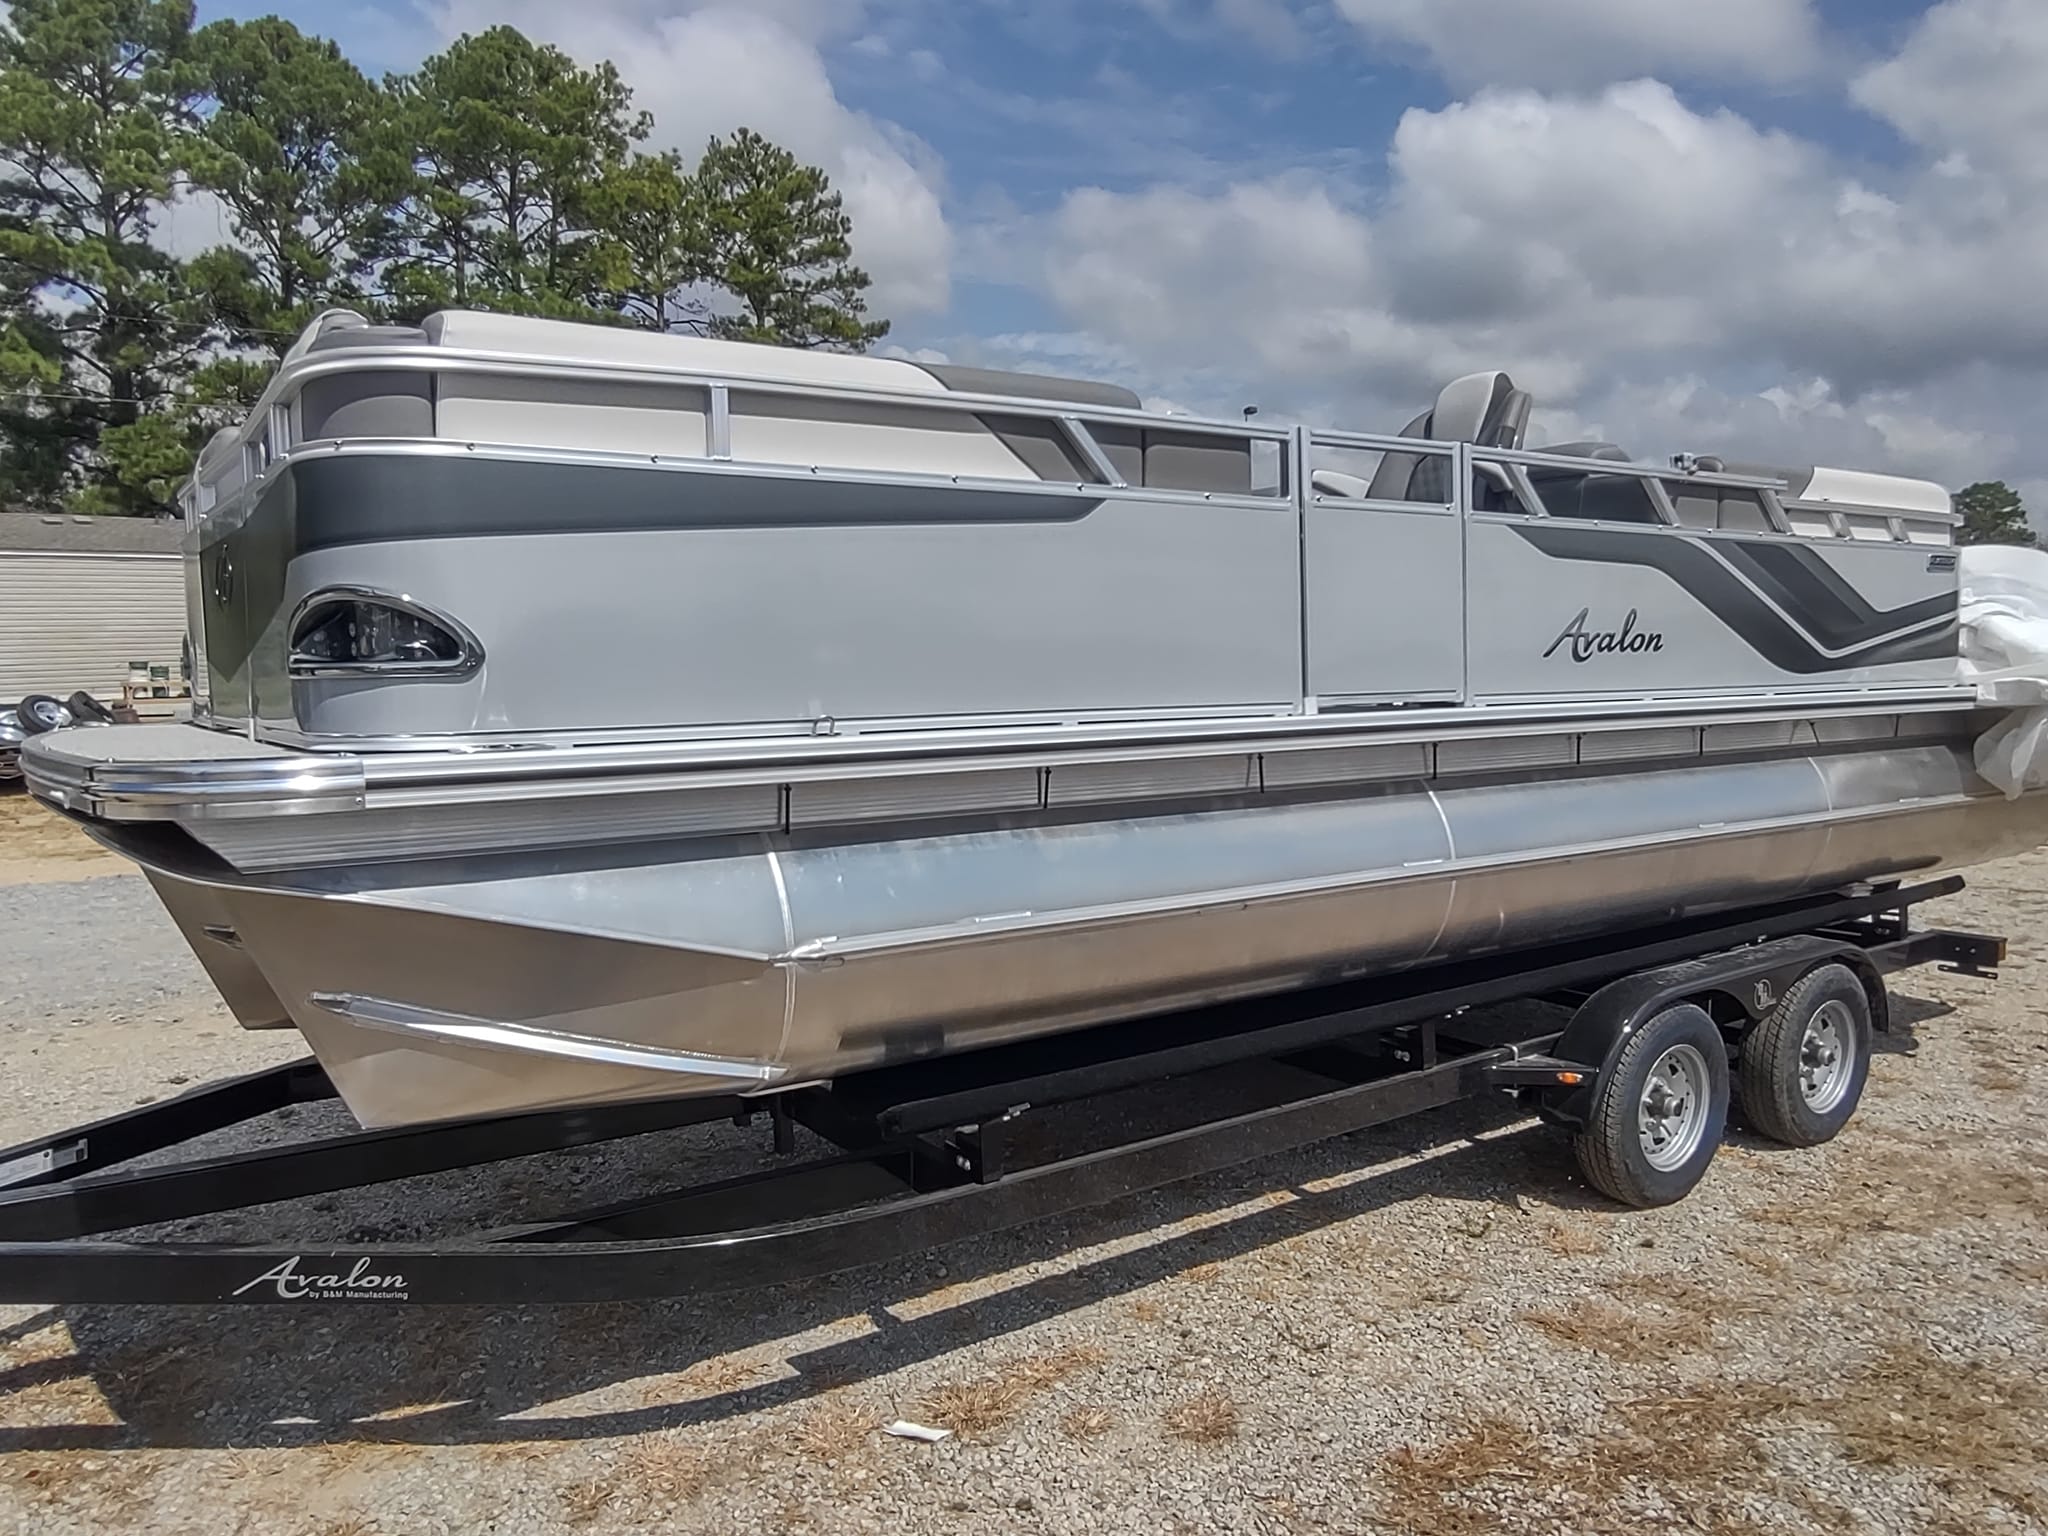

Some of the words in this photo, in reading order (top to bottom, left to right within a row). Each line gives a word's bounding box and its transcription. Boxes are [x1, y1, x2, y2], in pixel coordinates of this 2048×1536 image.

[1543, 607, 1663, 662] Avalon
[232, 1256, 408, 1298] Avalon
[309, 1291, 320, 1299] by
[323, 1290, 343, 1298] B&M
[346, 1290, 408, 1300] Manufacturing
